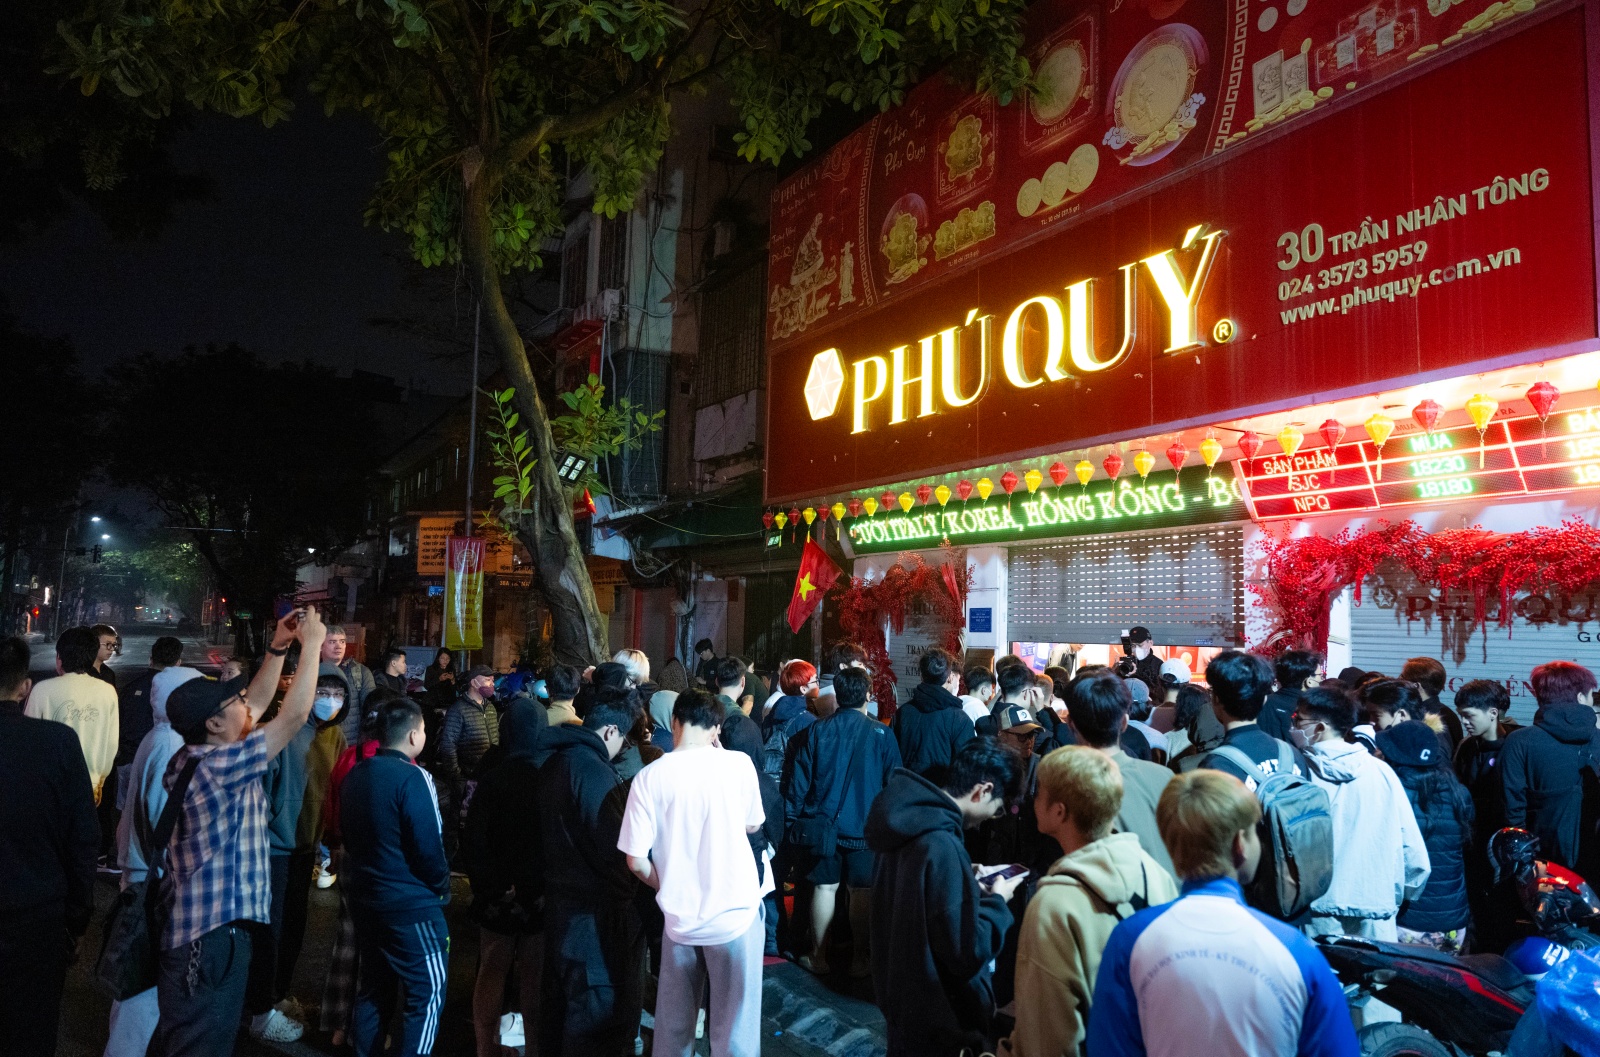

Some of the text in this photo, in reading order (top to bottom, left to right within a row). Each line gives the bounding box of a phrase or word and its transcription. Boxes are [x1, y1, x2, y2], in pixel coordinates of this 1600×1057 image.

[1276, 168, 1549, 271] 30 TRẦN NHÂN TÔNG
[1278, 241, 1428, 302] 024 3573 5959
[1280, 247, 1521, 325] www.phuquy.com.vn
[850, 308, 995, 434] PHÚ
[1002, 224, 1228, 390] QUÝ
[1409, 433, 1452, 453] MUA
[1291, 475, 1320, 492] SJC
[1409, 456, 1466, 477] 18230
[1293, 495, 1330, 513] NPQ
[1418, 478, 1473, 498] 18180
[946, 505, 1024, 534] KOREA,
[1095, 480, 1186, 518] KÔNG
[1205, 477, 1235, 507] B
[1576, 632, 1600, 643] G
[1420, 748, 1431, 761] C
